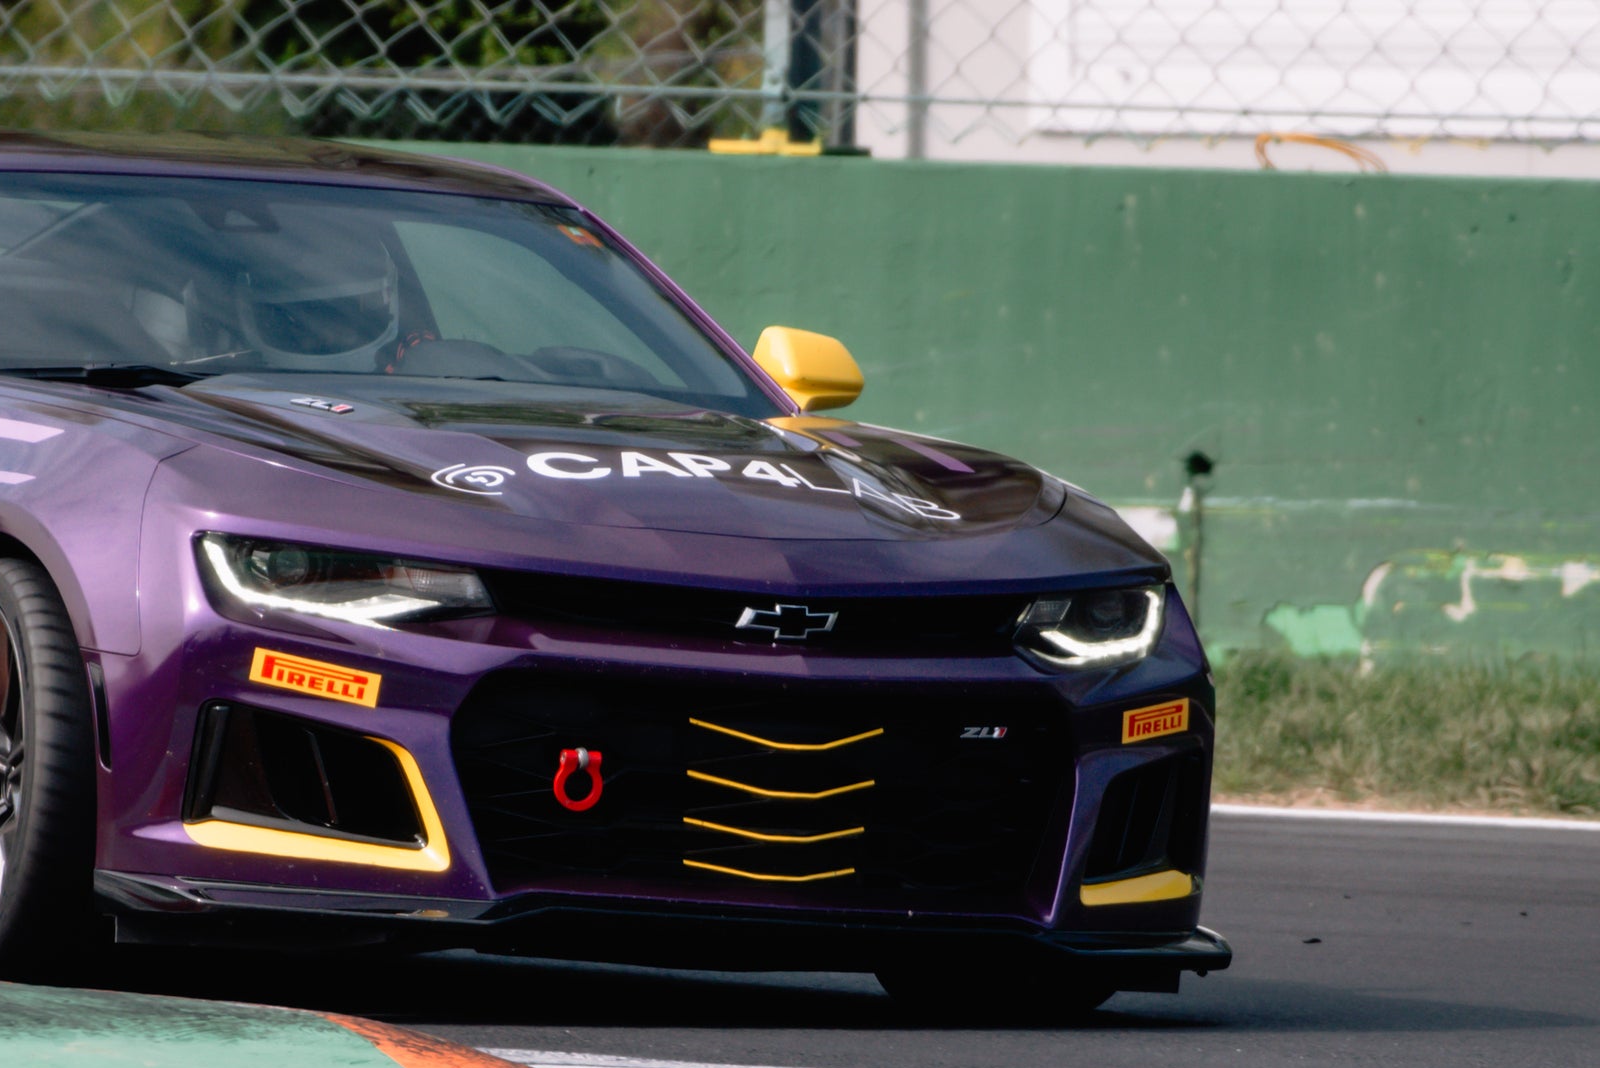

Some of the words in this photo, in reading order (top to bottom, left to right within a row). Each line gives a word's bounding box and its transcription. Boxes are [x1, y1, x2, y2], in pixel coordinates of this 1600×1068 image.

[526, 451, 962, 521] CAP4LAB
[260, 654, 369, 700] PIRELLI
[959, 726, 1008, 739] ZL1
[1128, 704, 1184, 739] PIRELLI
